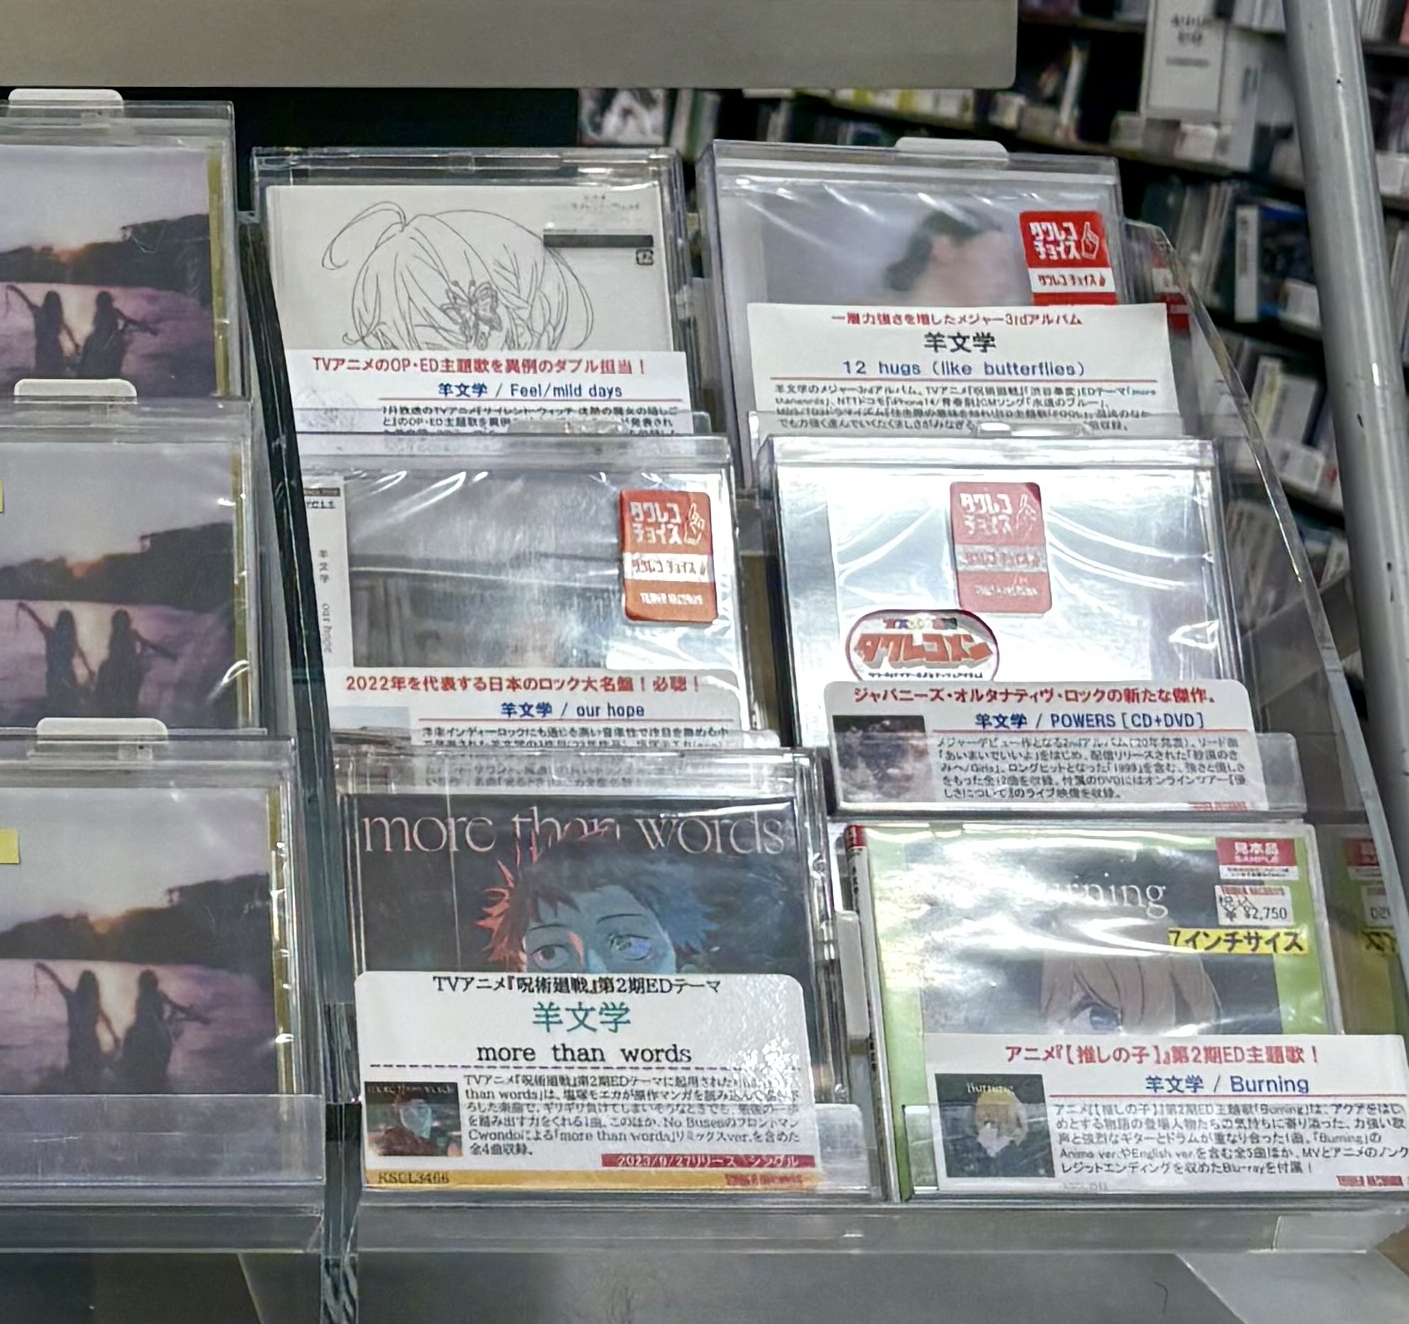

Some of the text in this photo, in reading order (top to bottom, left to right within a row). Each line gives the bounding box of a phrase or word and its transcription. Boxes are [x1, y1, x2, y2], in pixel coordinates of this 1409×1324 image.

[924, 331, 996, 353] 羊文学
[843, 360, 867, 374] 12
[878, 360, 921, 377] hugs
[933, 360, 972, 376] (like
[439, 382, 487, 398] 羊文学
[588, 383, 623, 400] days
[500, 702, 552, 718] 羊文学
[576, 706, 602, 717] our
[607, 702, 645, 719] hope
[975, 713, 1027, 729] 羊文学
[1050, 714, 1117, 728] POWERS
[362, 815, 494, 853] more
[635, 814, 786, 855] words
[1168, 927, 1305, 954] 7インチサイズ
[532, 1002, 632, 1034] 羊文学
[477, 1044, 692, 1064] more than words
[1145, 1075, 1204, 1093] 羊文学
[1230, 1076, 1309, 1094] Burning
